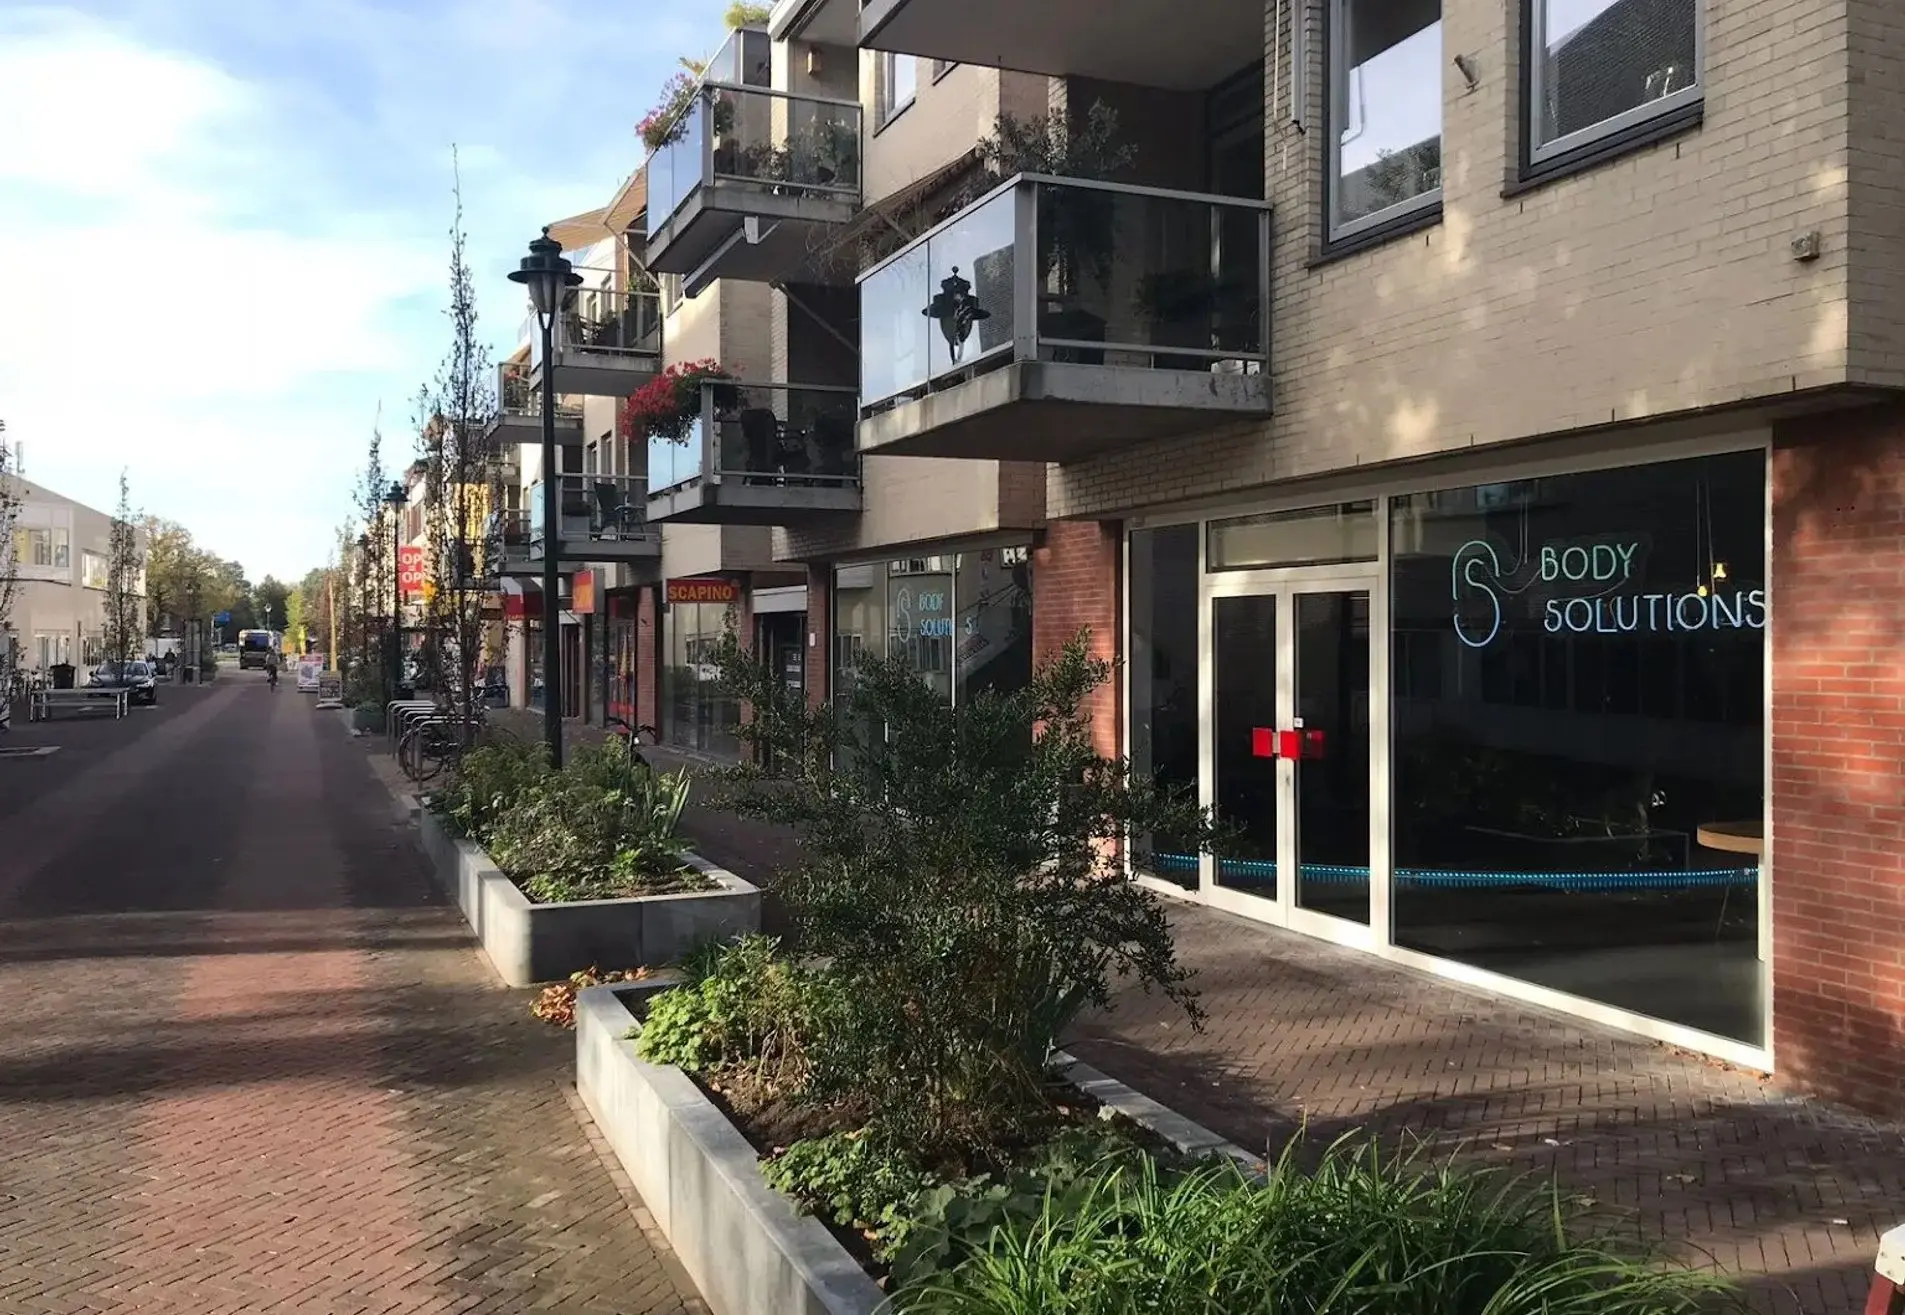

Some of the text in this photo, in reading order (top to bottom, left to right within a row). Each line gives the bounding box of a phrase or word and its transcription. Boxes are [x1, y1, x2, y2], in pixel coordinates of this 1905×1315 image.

[1541, 543, 1638, 581] BODY
[668, 585, 733, 600] SCAPINO
[1544, 590, 1765, 632] SOLUTIONS
